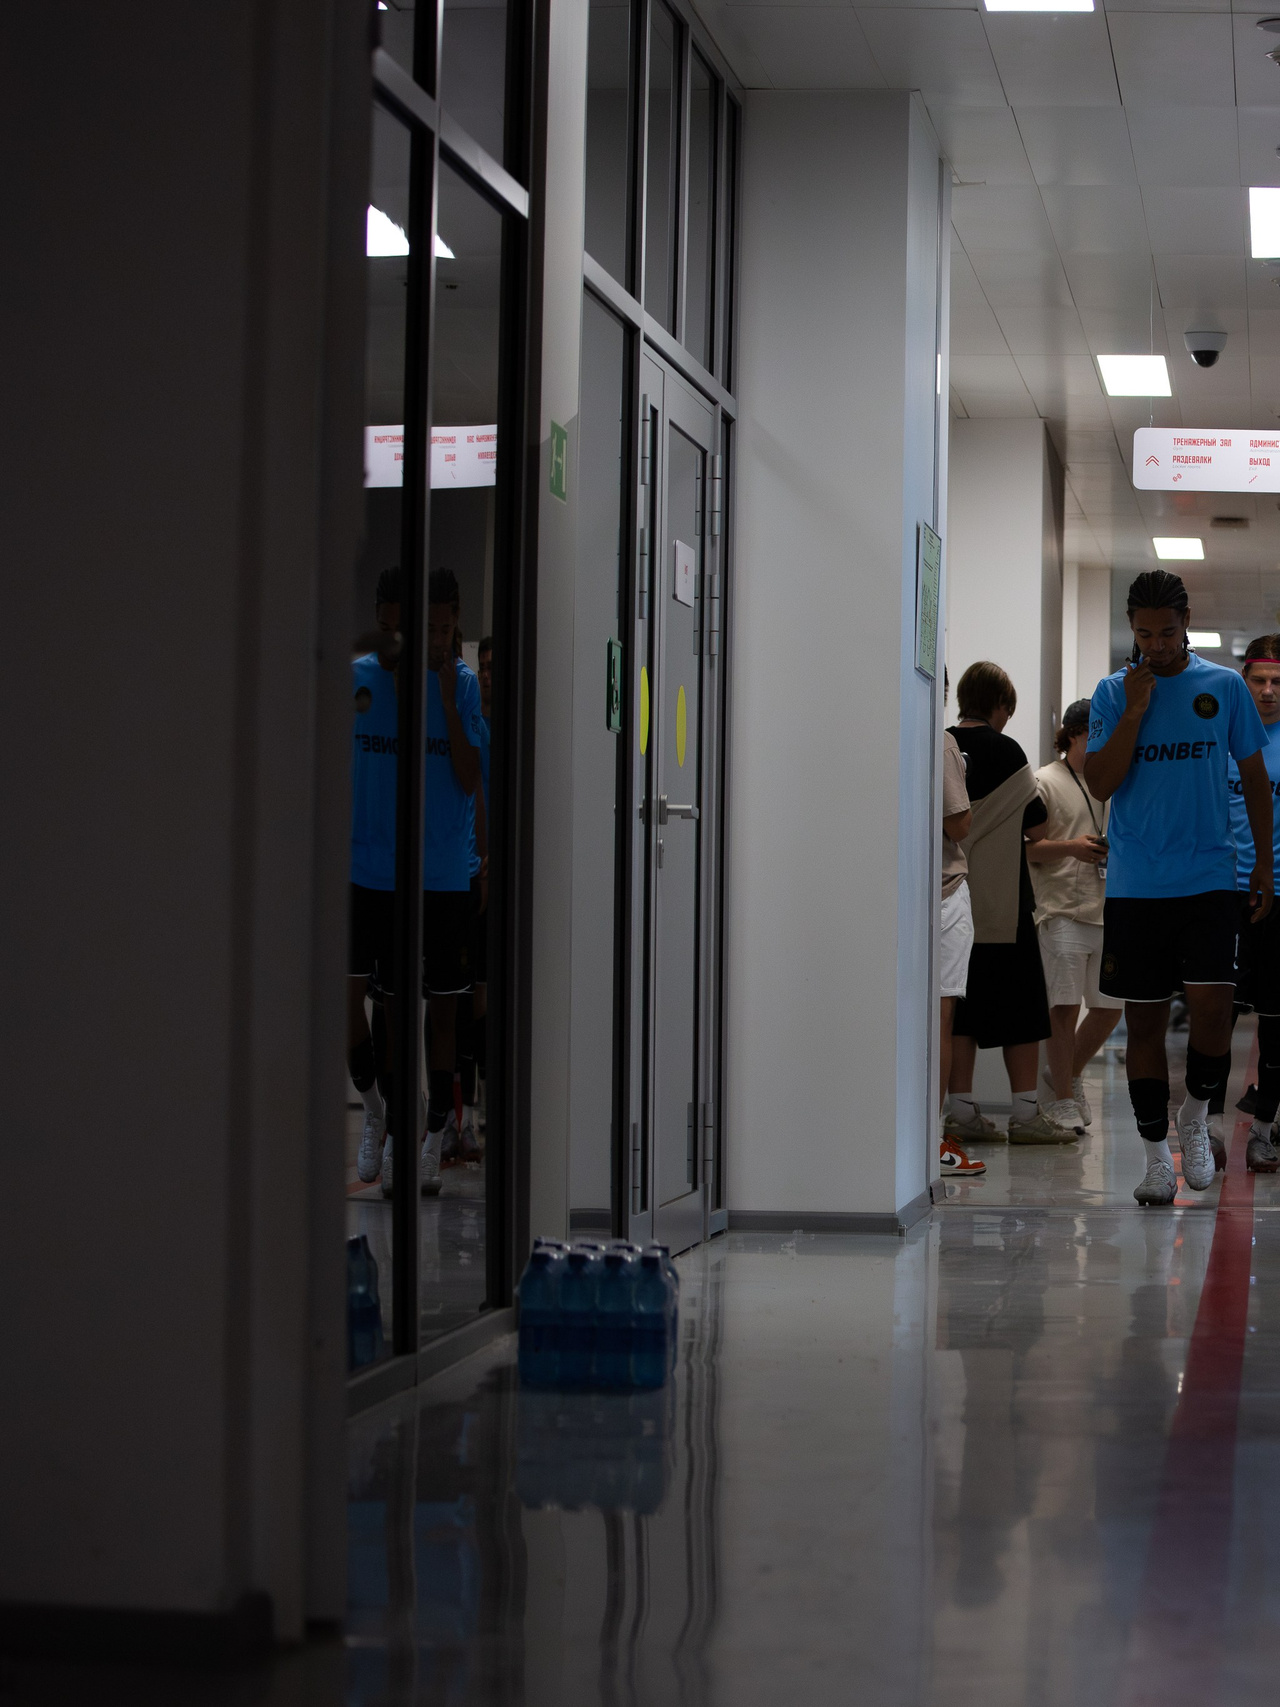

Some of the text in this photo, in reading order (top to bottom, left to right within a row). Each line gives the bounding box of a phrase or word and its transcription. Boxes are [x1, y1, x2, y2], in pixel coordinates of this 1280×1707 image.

[1173, 437, 1232, 448] ТРЕНАЖЕРНЫЙ ЗАЛ
[1172, 455, 1212, 464] РАЗДЕВАЛКИ
[1249, 457, 1271, 467] ВЫХОД
[1134, 741, 1217, 763] FONBET
